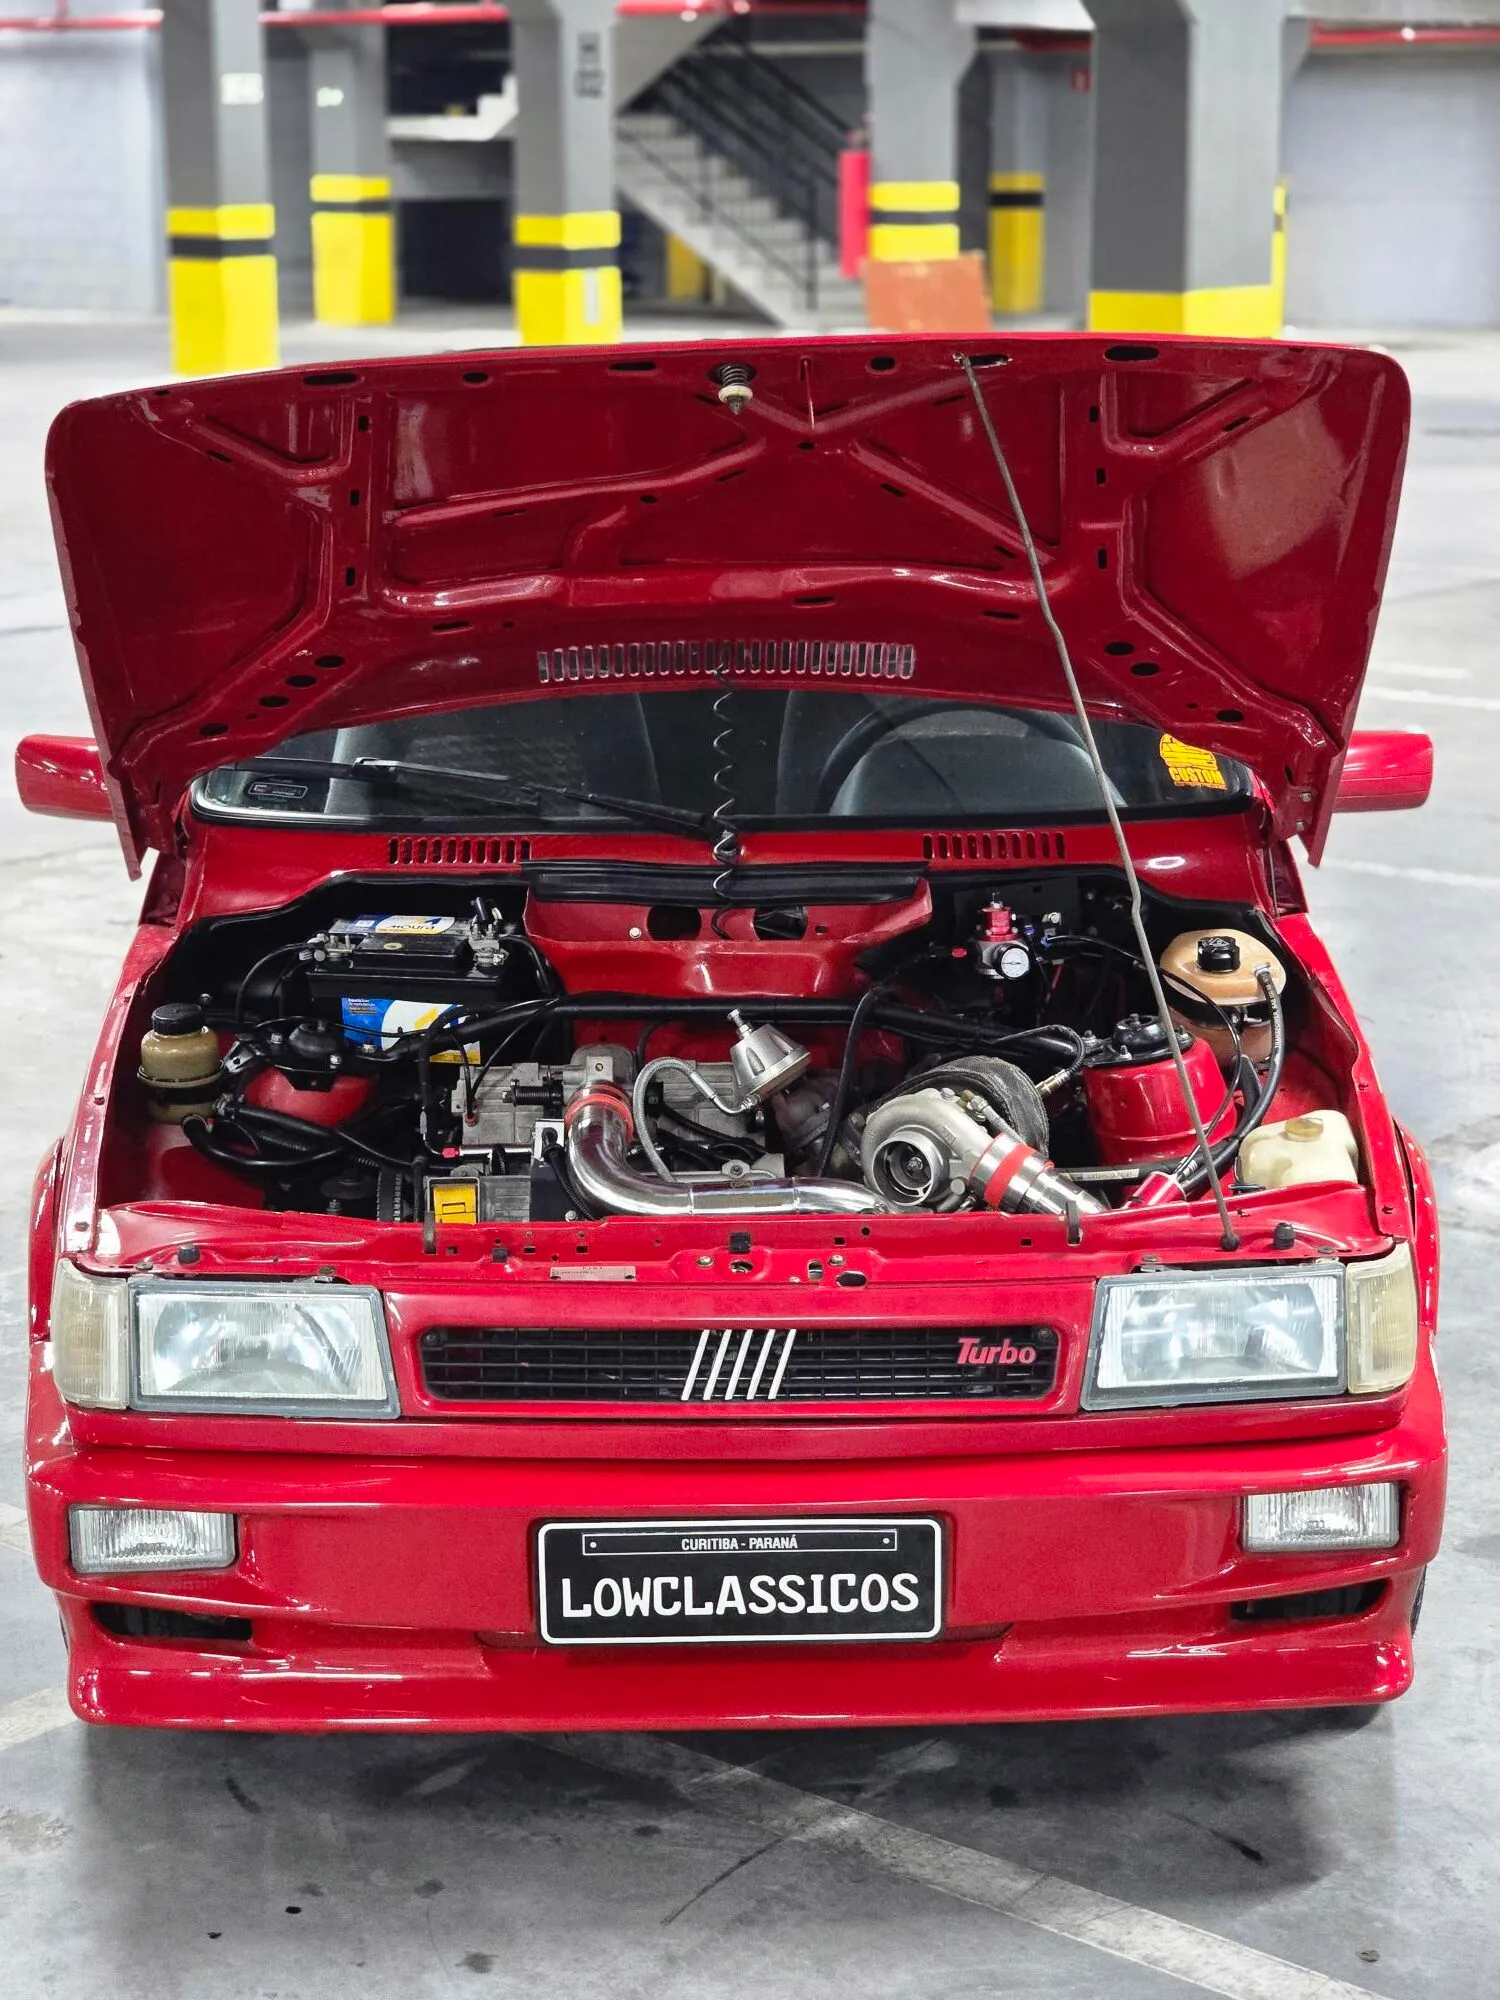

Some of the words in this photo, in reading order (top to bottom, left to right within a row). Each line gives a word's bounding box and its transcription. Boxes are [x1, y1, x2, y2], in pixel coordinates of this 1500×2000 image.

[1168, 766, 1226, 785] CUSTOM
[957, 1337, 1037, 1364] Turbo
[681, 1538, 739, 1551] CURITIBA
[749, 1534, 798, 1549] PARANÁ
[561, 1572, 919, 1618] LOWCLASSICOS
